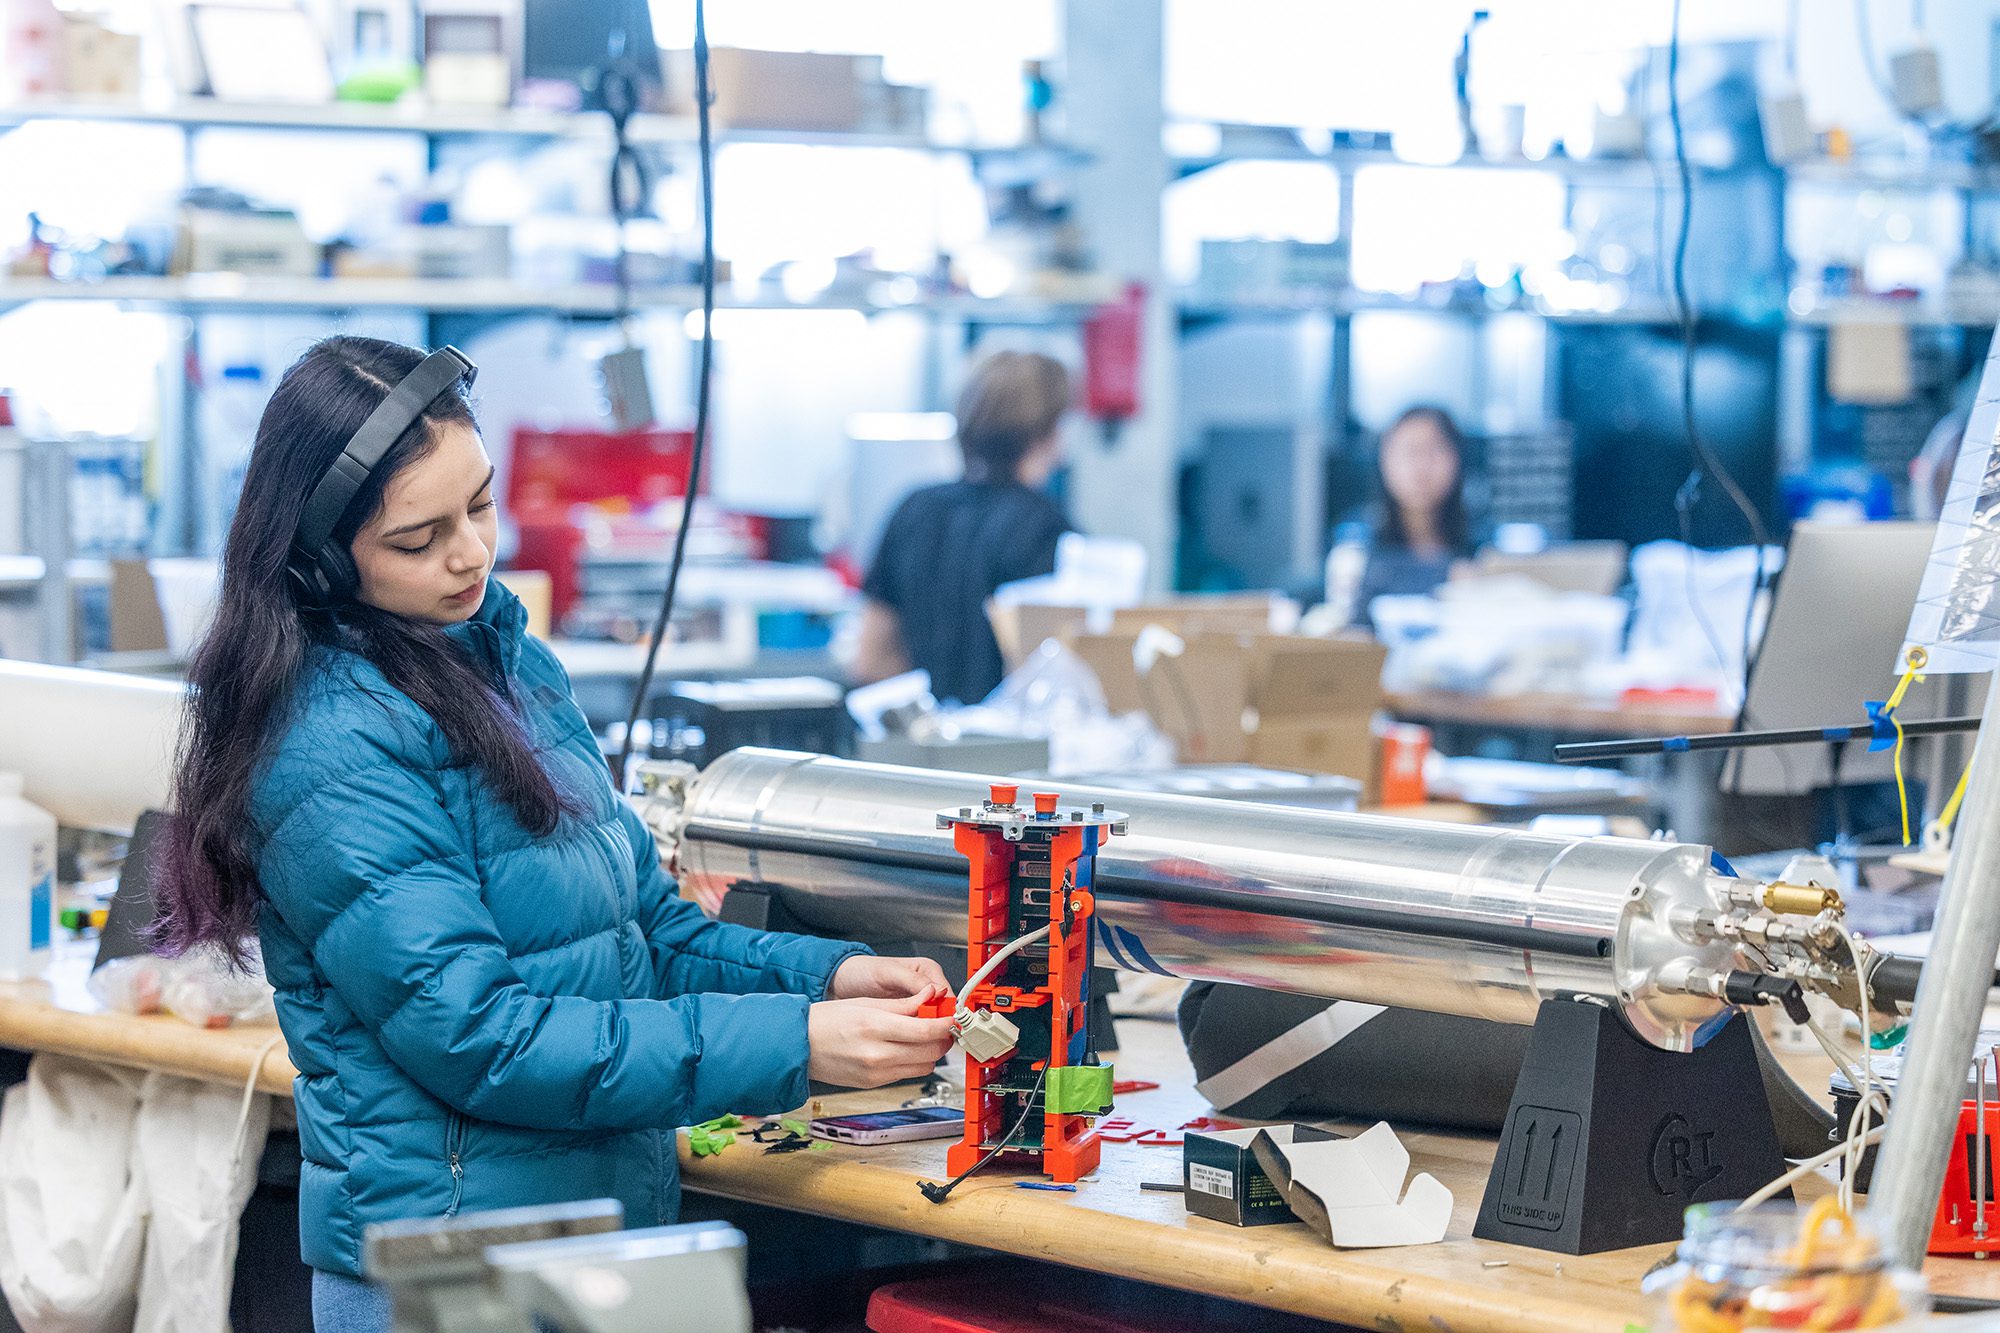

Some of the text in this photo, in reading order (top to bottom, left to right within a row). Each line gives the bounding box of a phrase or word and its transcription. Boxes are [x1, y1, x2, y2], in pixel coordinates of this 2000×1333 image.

[1502, 1203, 1560, 1222] THIS SIDE UP
